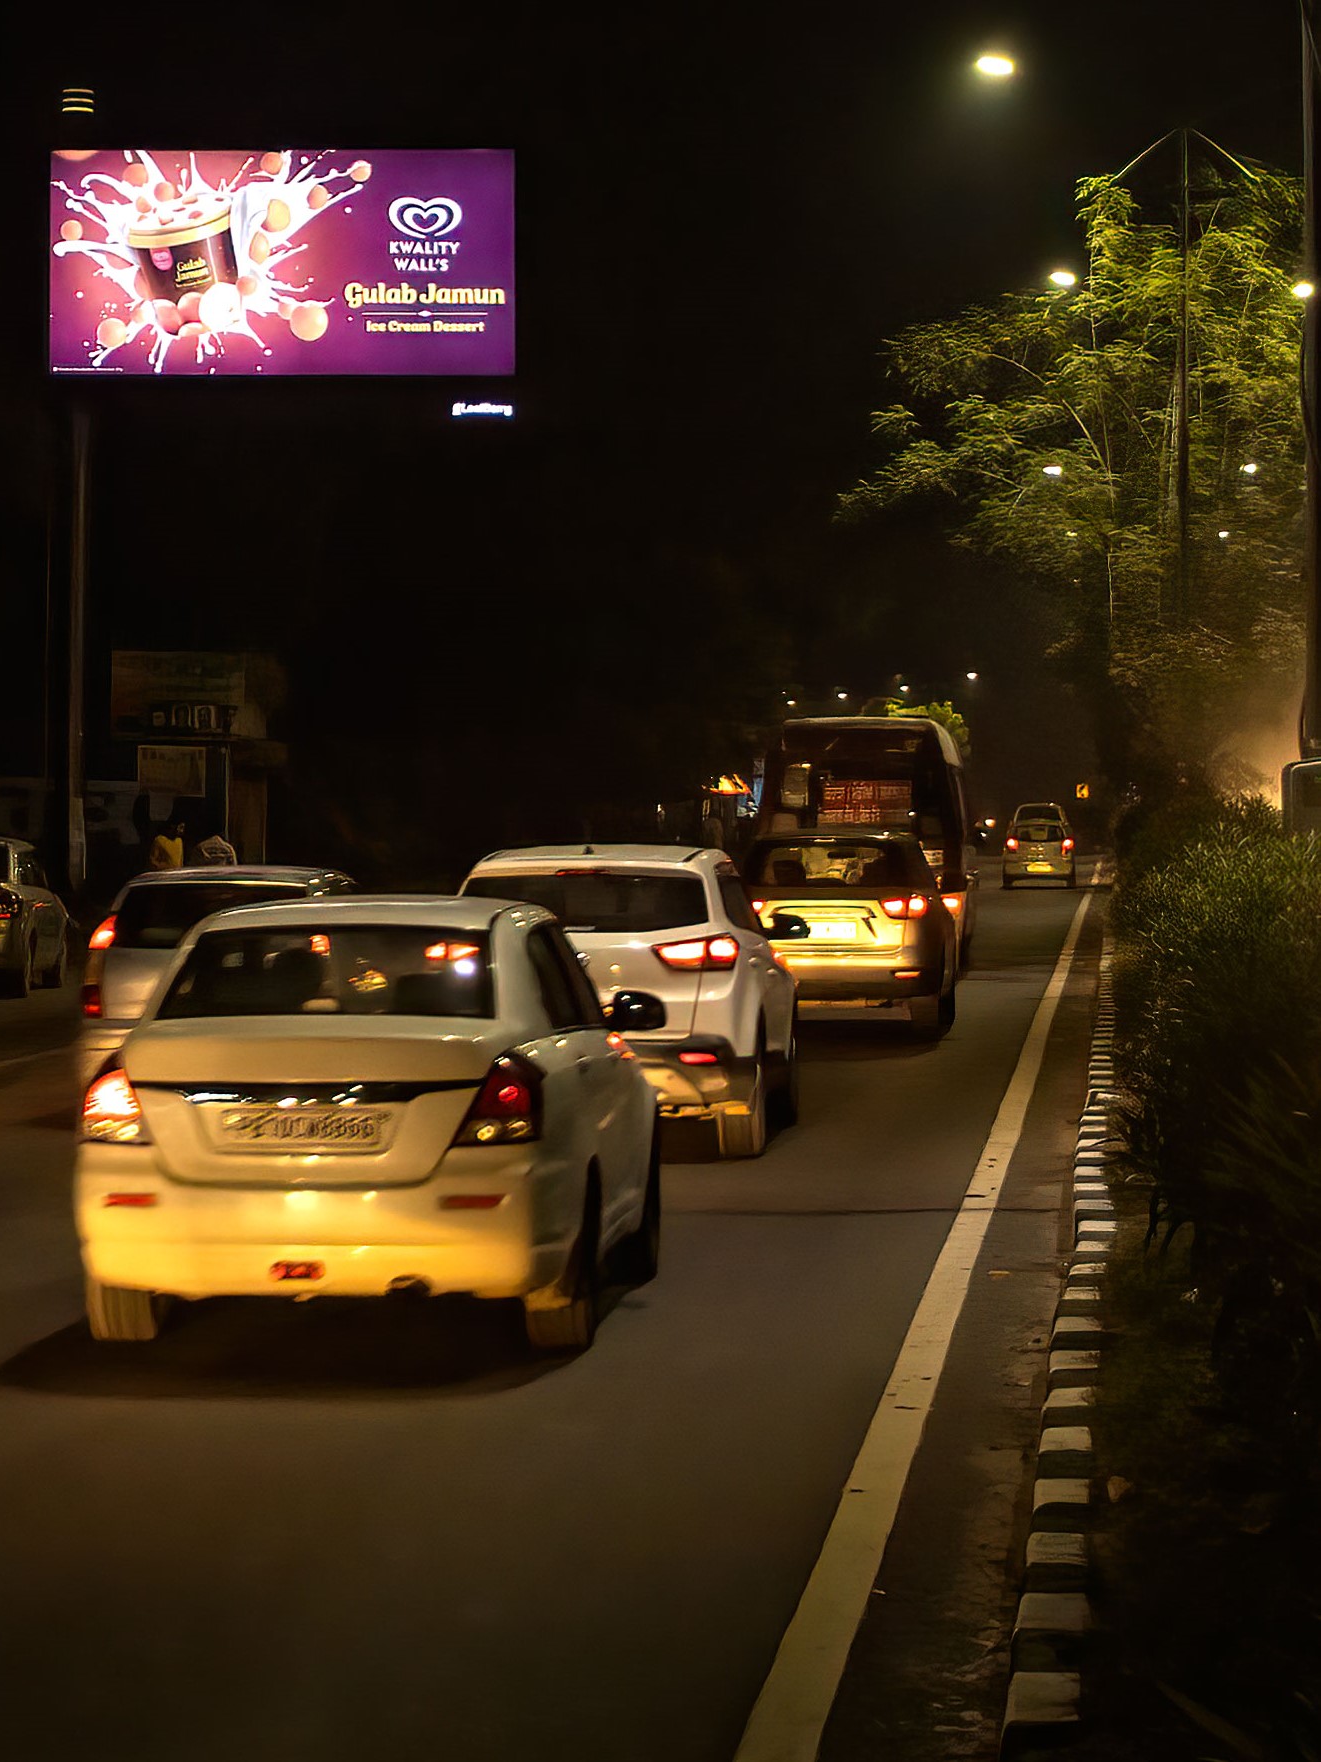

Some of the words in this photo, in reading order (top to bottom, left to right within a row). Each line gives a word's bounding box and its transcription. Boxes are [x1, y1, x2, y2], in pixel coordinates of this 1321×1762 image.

[389, 240, 461, 255] KWALITY
[393, 257, 449, 272] WALL'S
[344, 282, 418, 309] Gulab
[418, 282, 506, 306] Jamun
[366, 320, 387, 333] Ice
[387, 320, 432, 333] Cream
[432, 320, 485, 333] Dessert
